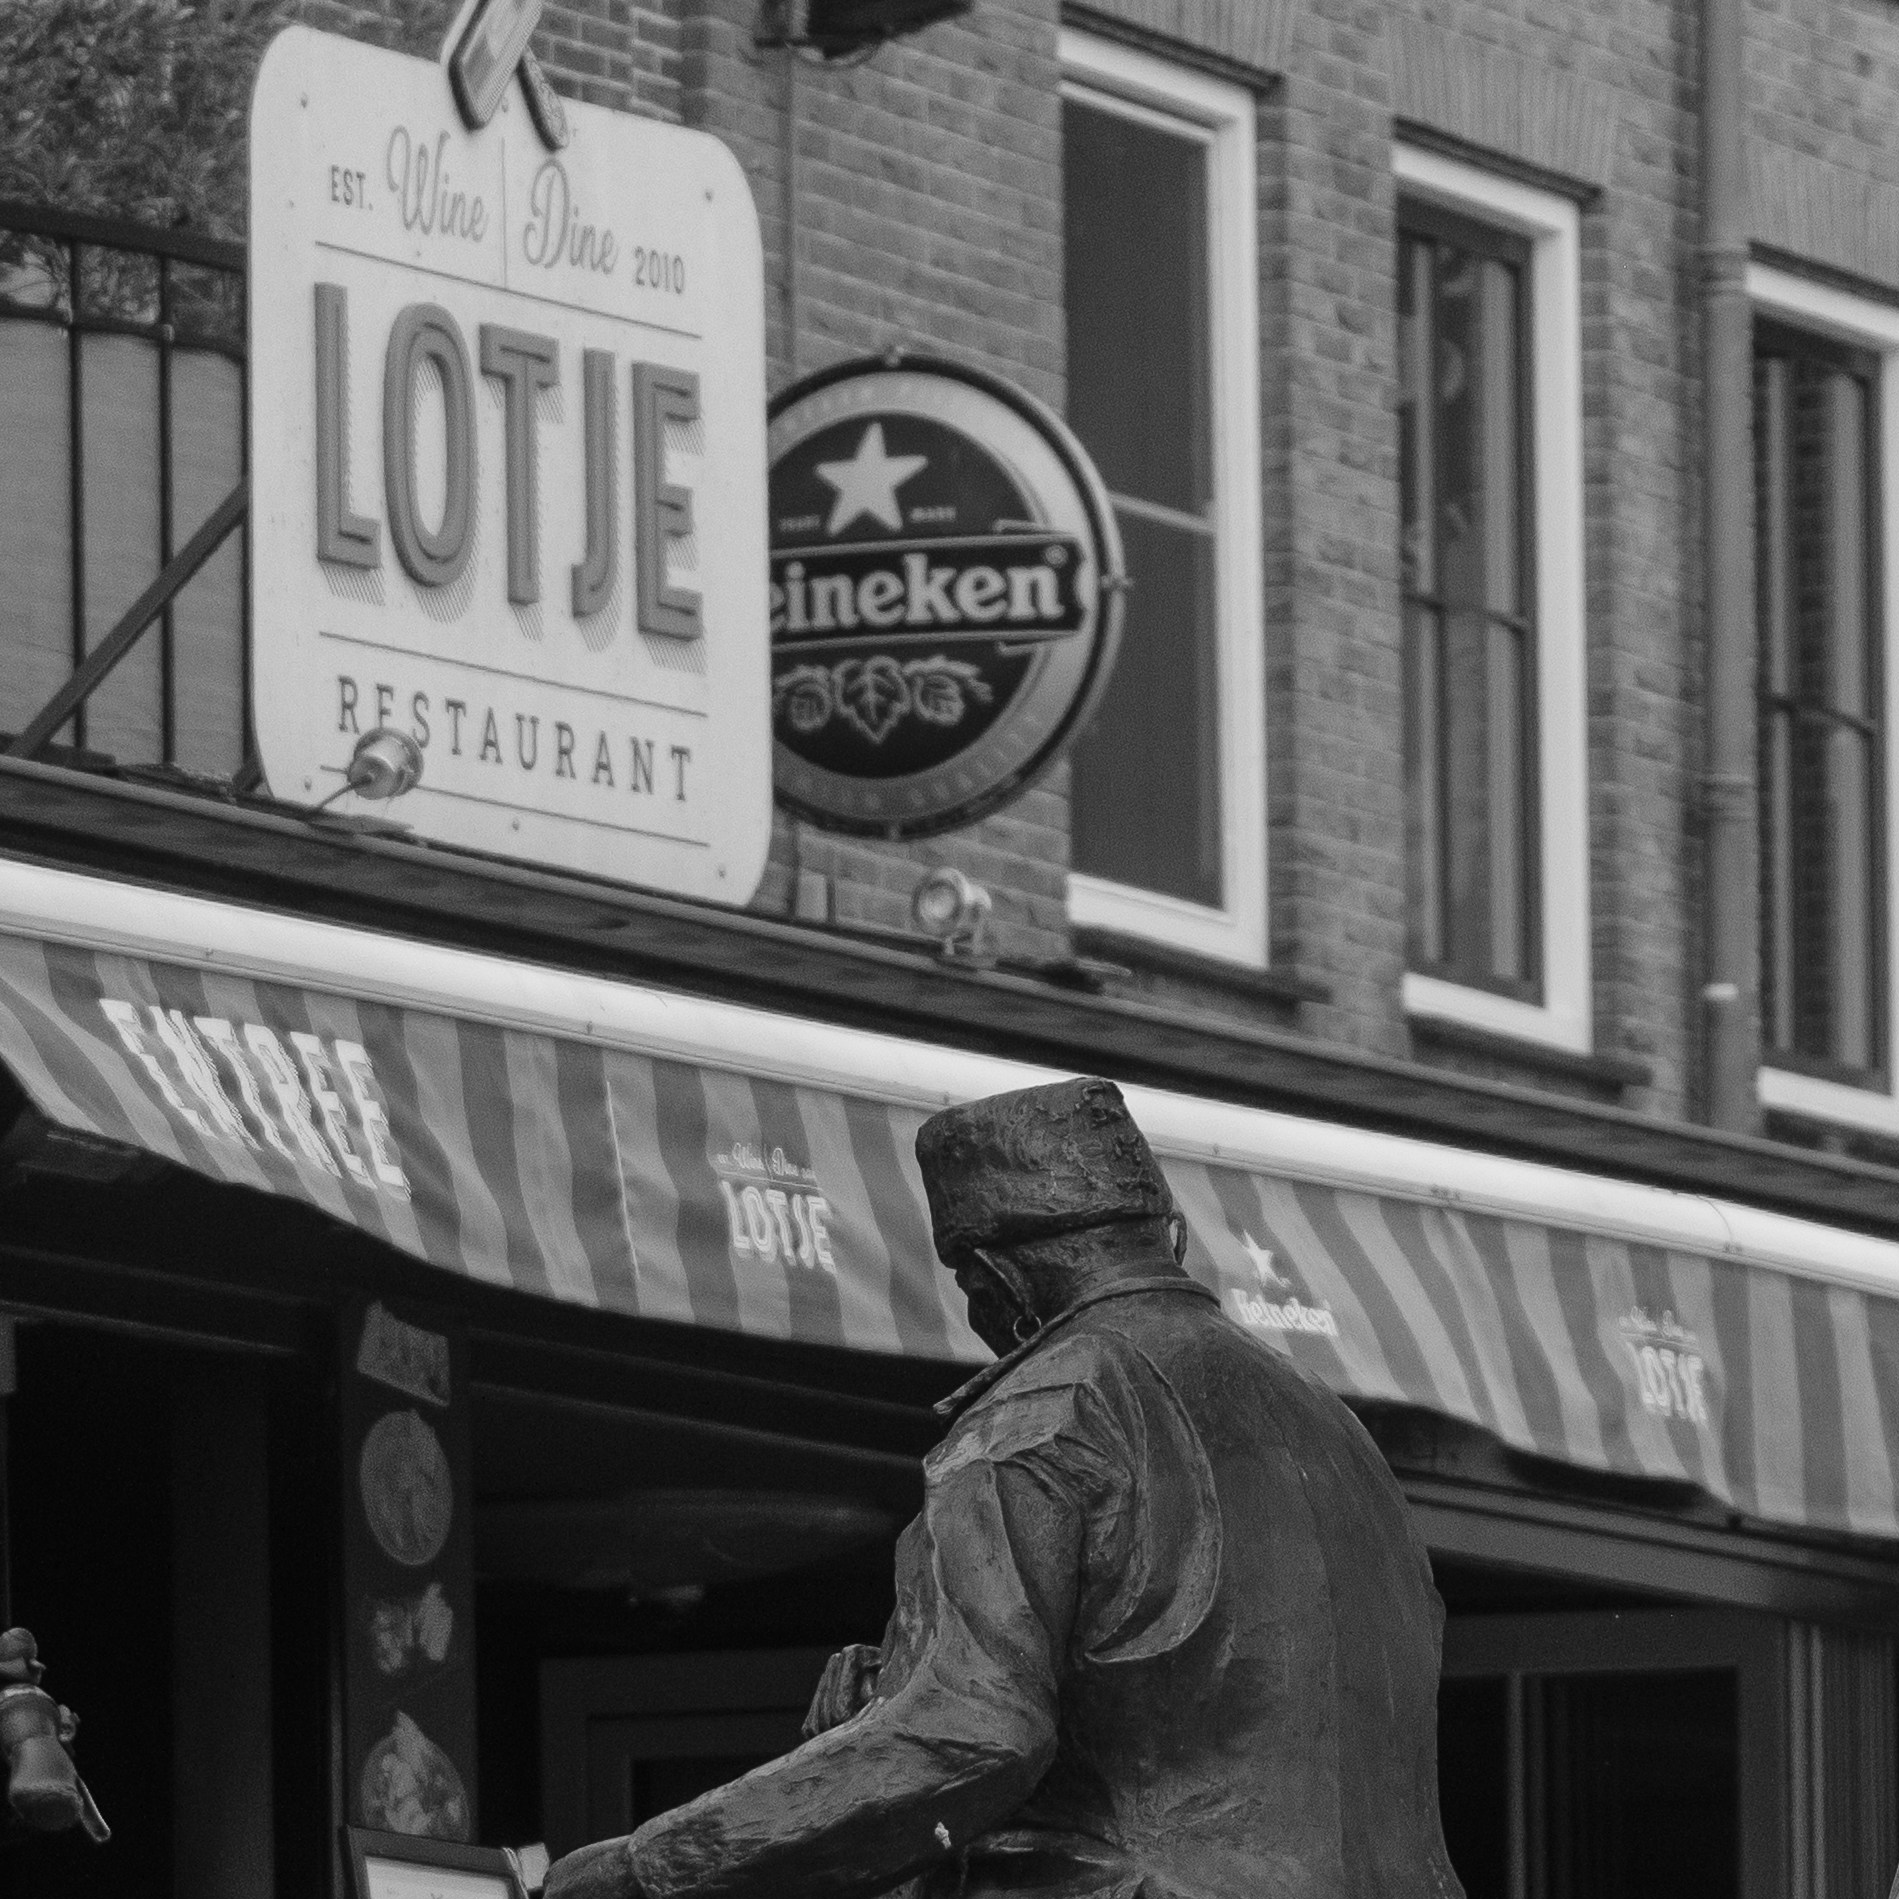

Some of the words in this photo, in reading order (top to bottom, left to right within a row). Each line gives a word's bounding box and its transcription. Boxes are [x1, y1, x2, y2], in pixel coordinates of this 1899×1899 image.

[329, 164, 374, 210] EST.
[386, 126, 488, 243] Wine
[523, 158, 618, 275] Dine
[633, 246, 686, 295] 2010
[313, 281, 705, 648] LOTJE
[337, 674, 692, 801] RESTAURANT
[99, 998, 411, 1196] ENTREE
[721, 1180, 838, 1275] LOTJE
[1230, 1287, 1338, 1338] Heineken
